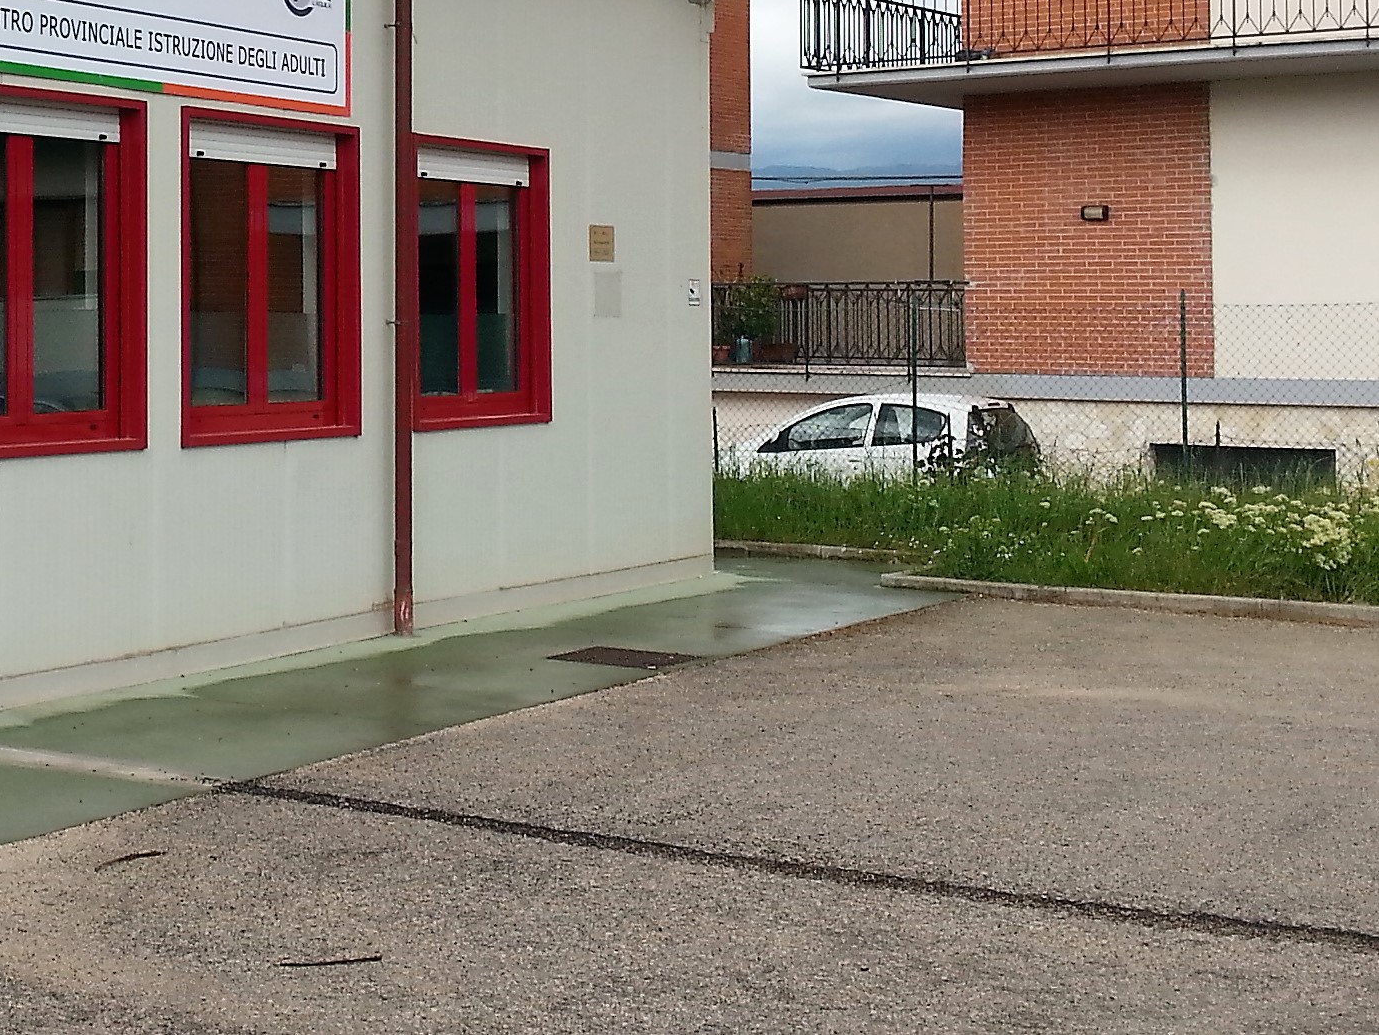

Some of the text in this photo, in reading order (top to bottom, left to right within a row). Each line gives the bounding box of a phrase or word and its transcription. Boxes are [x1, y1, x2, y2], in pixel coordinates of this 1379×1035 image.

[39, 13, 143, 50] PROVINCIALE
[148, 31, 234, 64] ISTRUZIONE
[238, 45, 277, 70] DEGLI
[281, 53, 326, 77] ADULTI
